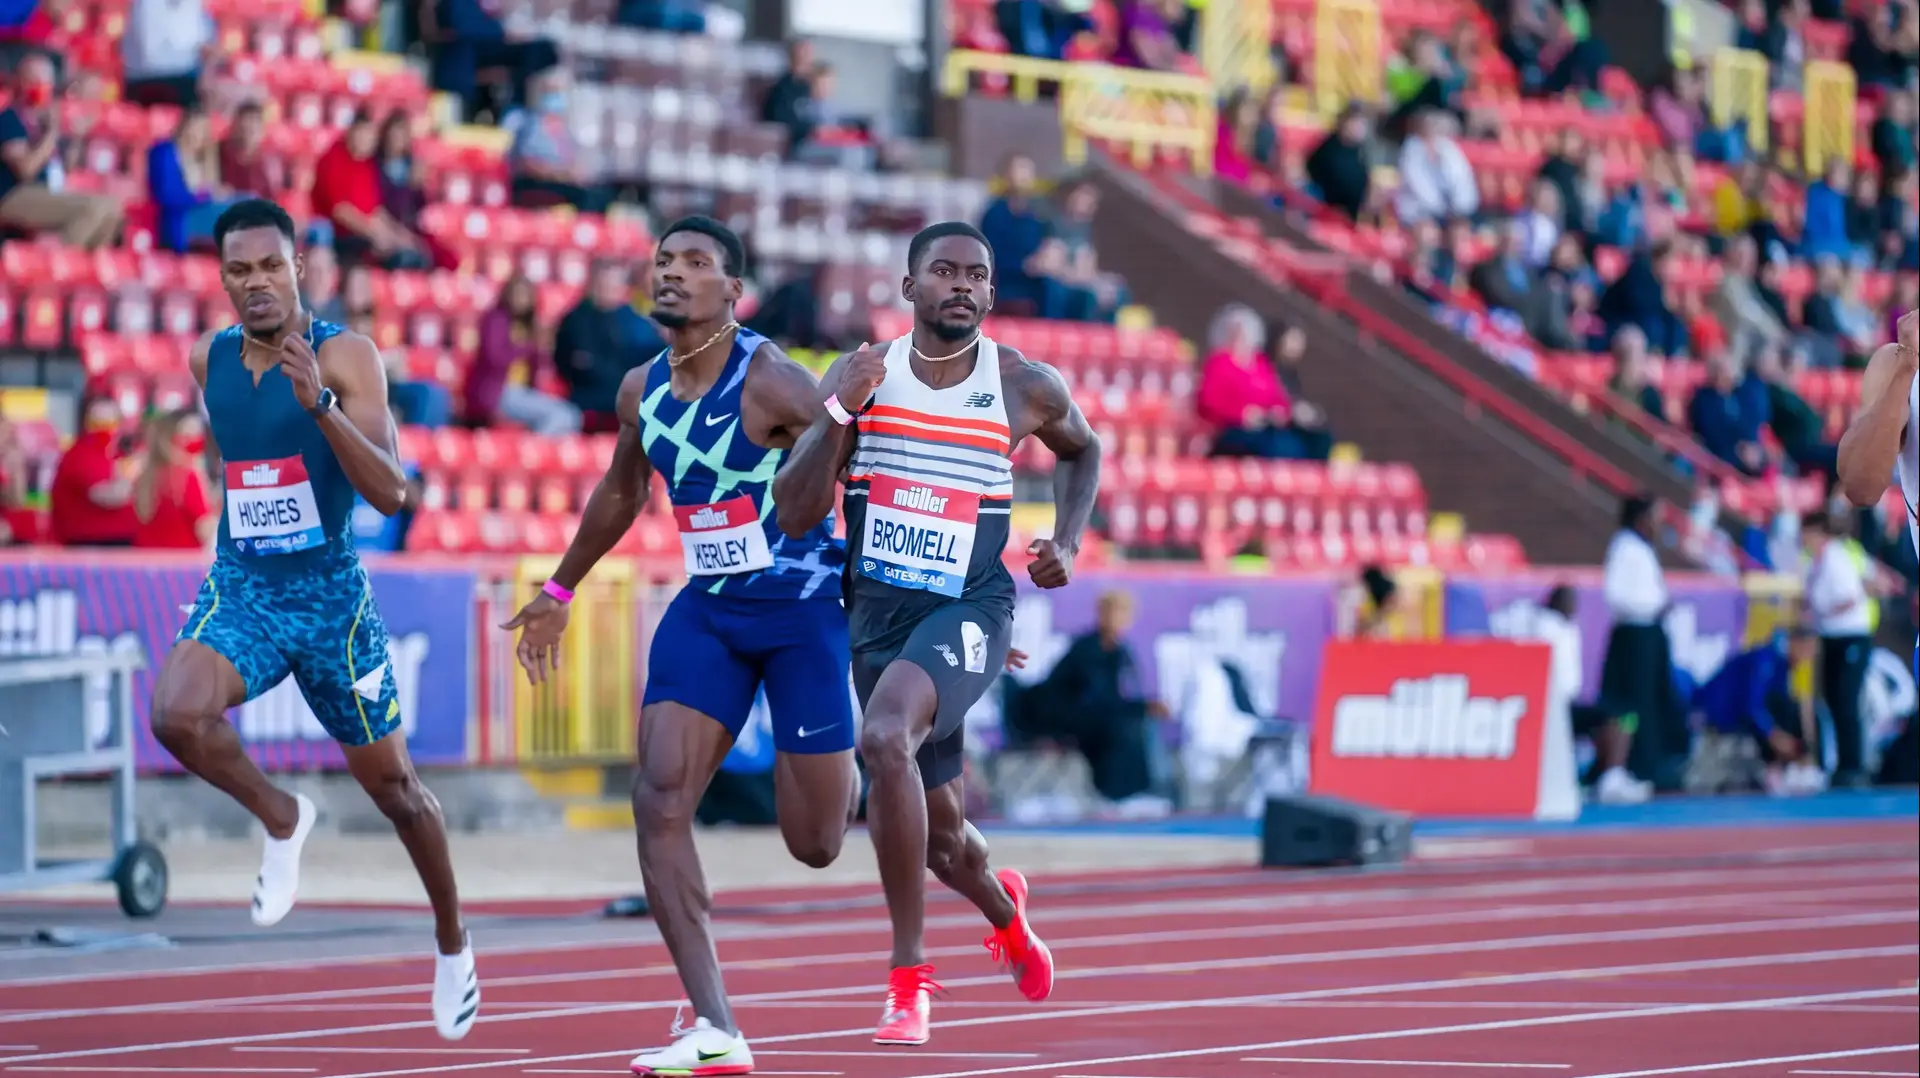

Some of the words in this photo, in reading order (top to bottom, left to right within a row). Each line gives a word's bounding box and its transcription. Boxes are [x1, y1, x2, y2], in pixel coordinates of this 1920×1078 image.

[238, 497, 301, 528] HUGHES
[892, 486, 949, 514] müller
[693, 536, 749, 569] KERLEY
[872, 518, 957, 565] BROMELL
[884, 566, 945, 587] GATESHEAD
[1331, 673, 1528, 760] müller
